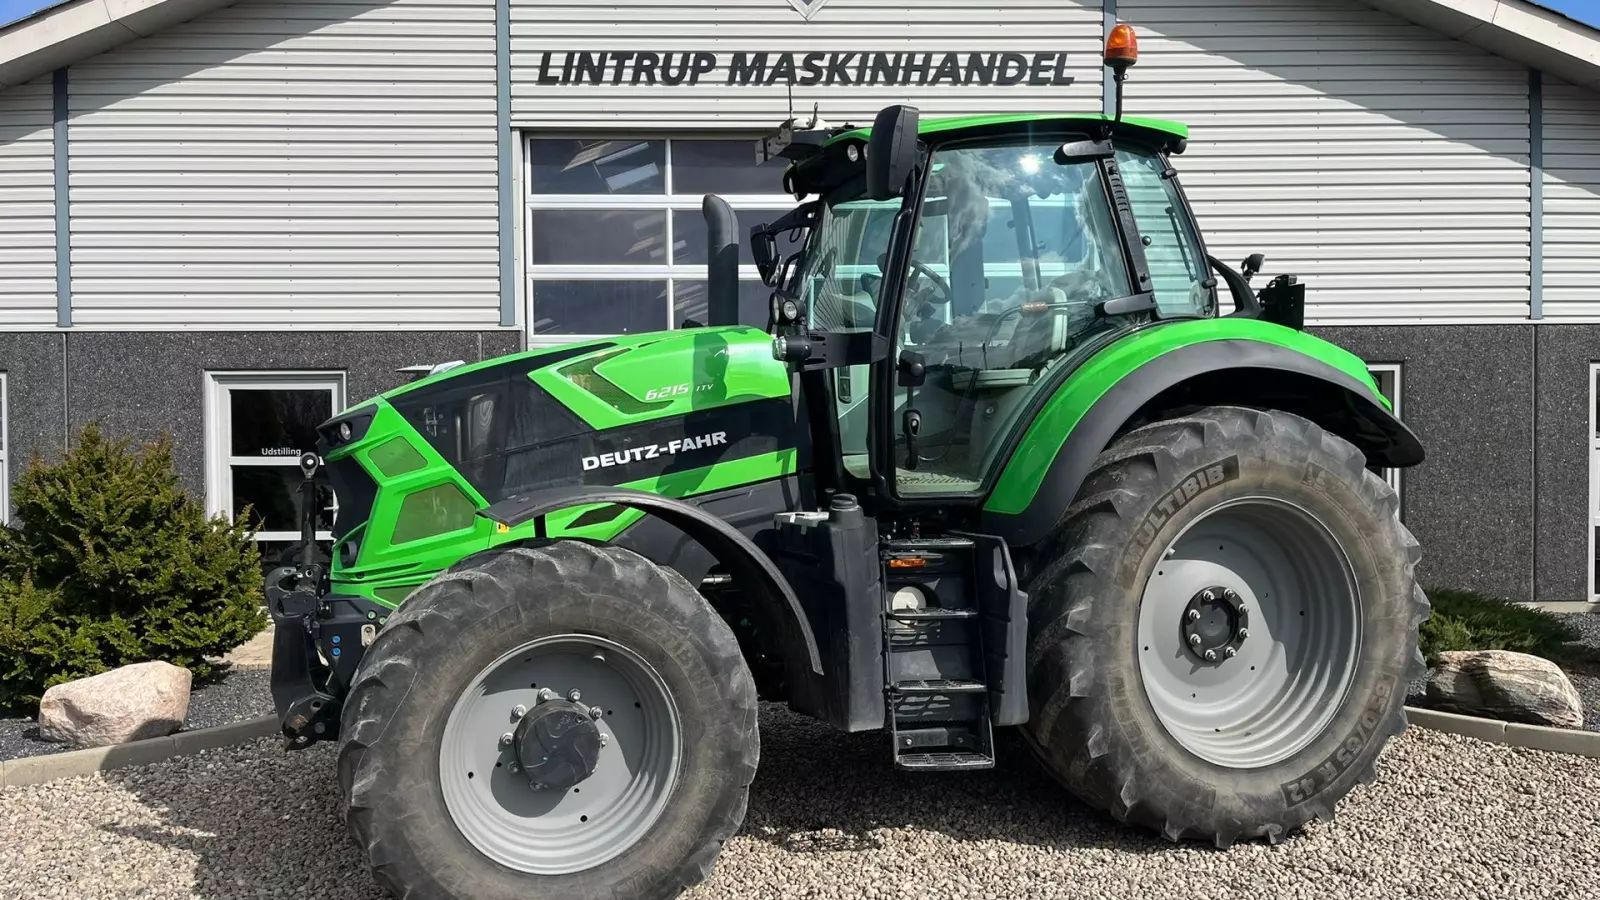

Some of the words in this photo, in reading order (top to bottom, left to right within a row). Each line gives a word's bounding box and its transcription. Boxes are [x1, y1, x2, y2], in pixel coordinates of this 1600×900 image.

[536, 51, 717, 86] LINTRUP
[728, 51, 1075, 86] MASKINHANDEL
[645, 383, 689, 401] 6215
[261, 447, 302, 457] Udstilling
[581, 431, 728, 471] DEUTZ-FAHR
[1286, 778, 1316, 801] 42
